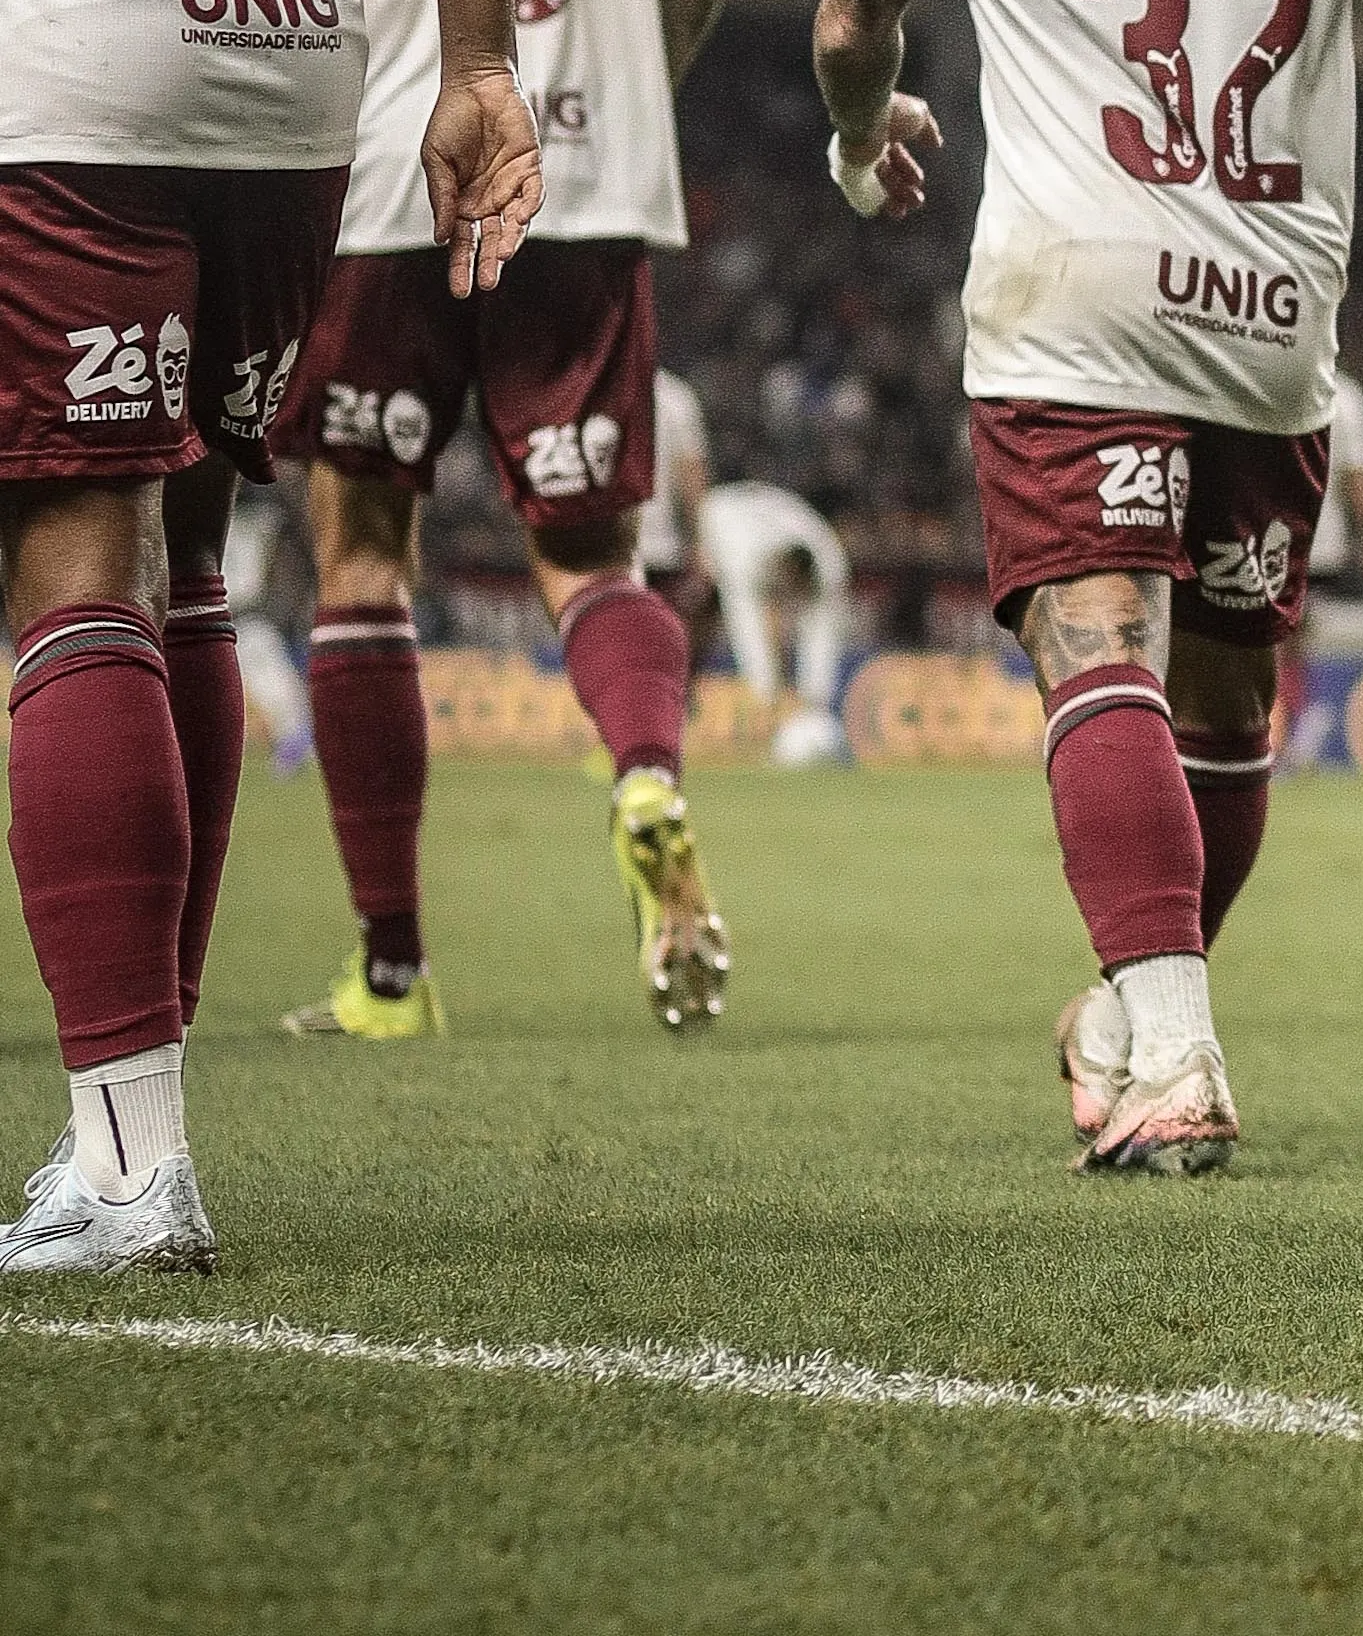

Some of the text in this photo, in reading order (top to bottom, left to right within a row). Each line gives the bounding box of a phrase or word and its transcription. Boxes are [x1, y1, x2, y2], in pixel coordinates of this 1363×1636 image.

[181, 28, 342, 54] UNIVERSIDADE IGUAÇU
[1158, 250, 1299, 328] UNIG
[64, 323, 153, 400] Zé
[66, 400, 152, 423] DELIVERY
[1096, 443, 1167, 507] Zé
